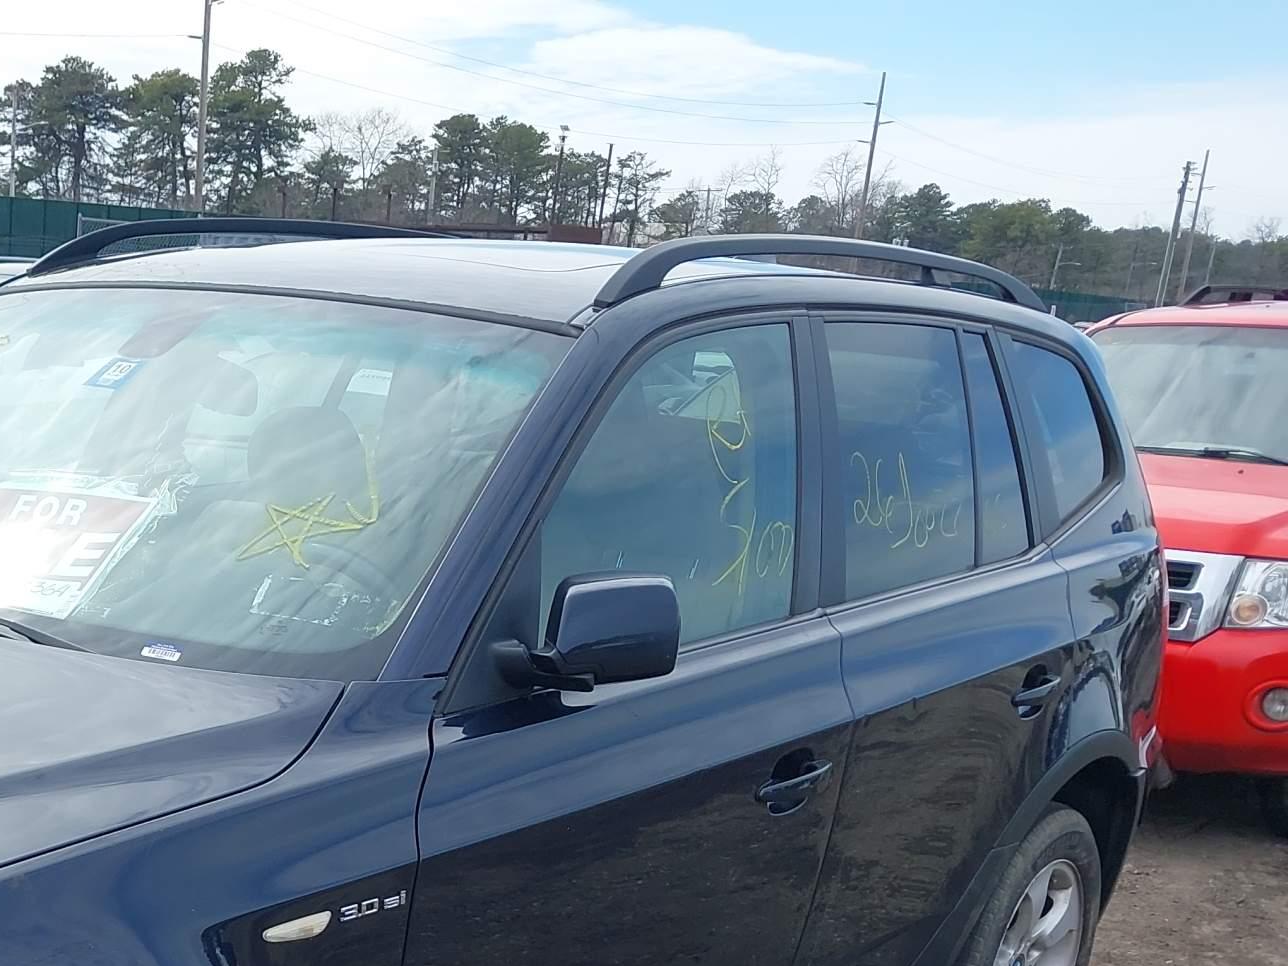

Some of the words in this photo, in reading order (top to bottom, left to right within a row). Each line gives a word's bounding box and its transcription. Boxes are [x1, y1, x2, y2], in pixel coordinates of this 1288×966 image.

[10, 494, 87, 526] FOR
[340, 898, 379, 922] 3.0
[384, 889, 407, 909] si
